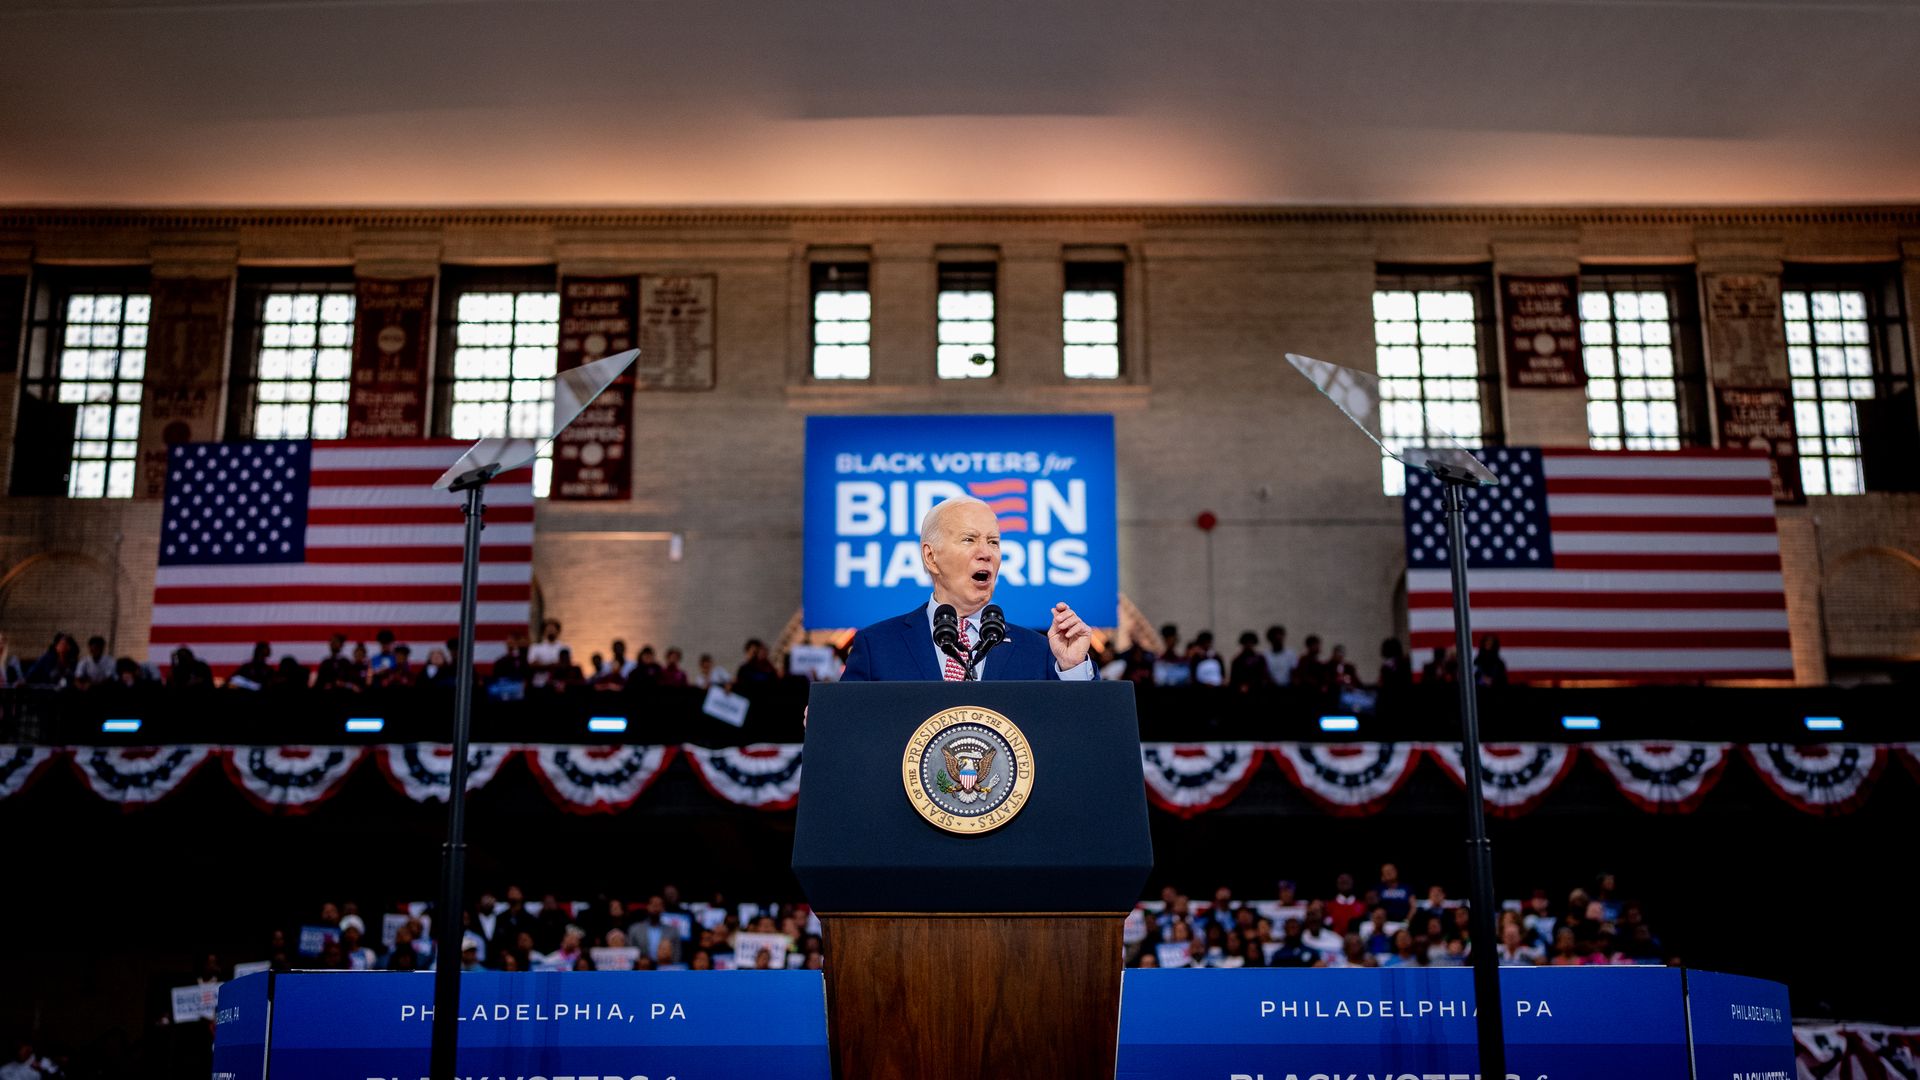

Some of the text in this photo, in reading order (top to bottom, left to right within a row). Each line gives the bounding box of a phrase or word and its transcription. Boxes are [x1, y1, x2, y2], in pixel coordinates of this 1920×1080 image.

[835, 450, 1076, 477] BLACK VOTERS for
[835, 538, 1092, 588] HARIS
[908, 710, 1030, 828] SEAL OF THE PRESIDENT OF THE UNITED STATES
[401, 1003, 686, 1023] PHADELPHIA, PA
[1261, 1001, 1552, 1017] PHILADELPHI PA
[1731, 1004, 1775, 1024] PHILADELPHIA,
